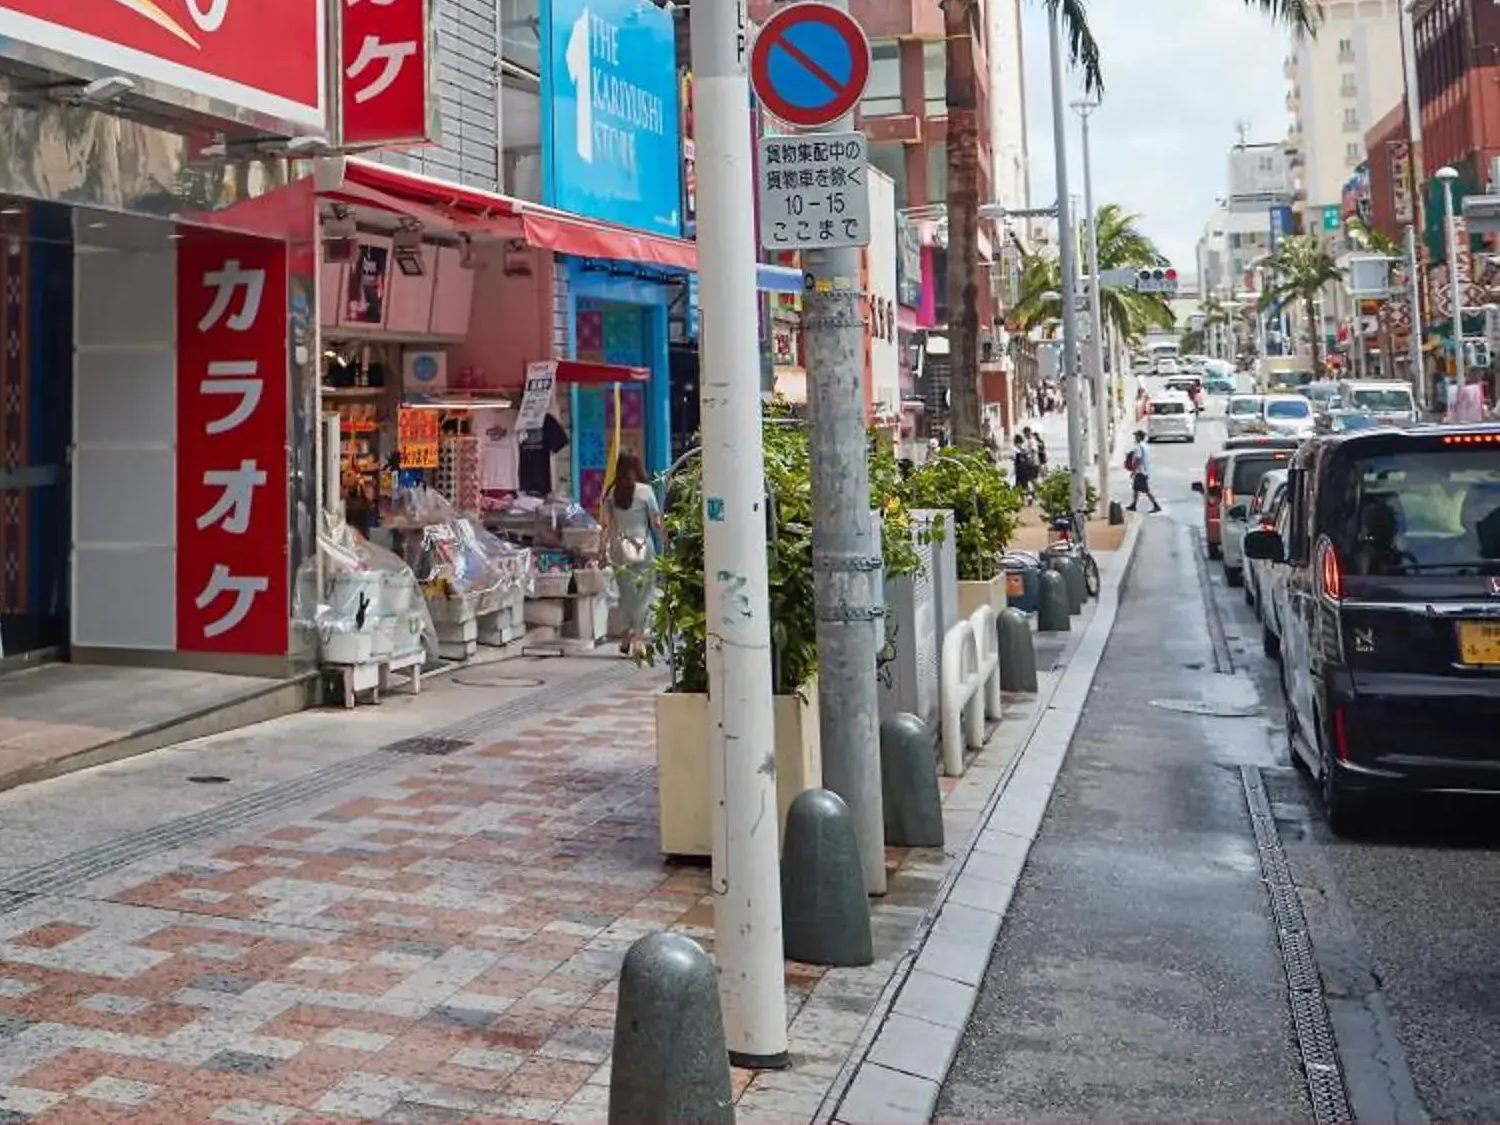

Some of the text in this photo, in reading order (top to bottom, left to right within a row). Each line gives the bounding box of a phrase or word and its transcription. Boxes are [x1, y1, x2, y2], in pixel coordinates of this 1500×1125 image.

[590, 14, 619, 65] THE
[592, 65, 664, 136] KARIYUSHI
[766, 140, 861, 165] 貨物集配中の
[766, 166, 862, 190] 貨物車を除く
[773, 218, 859, 242] ここまで
[195, 259, 269, 638] カラオケ
